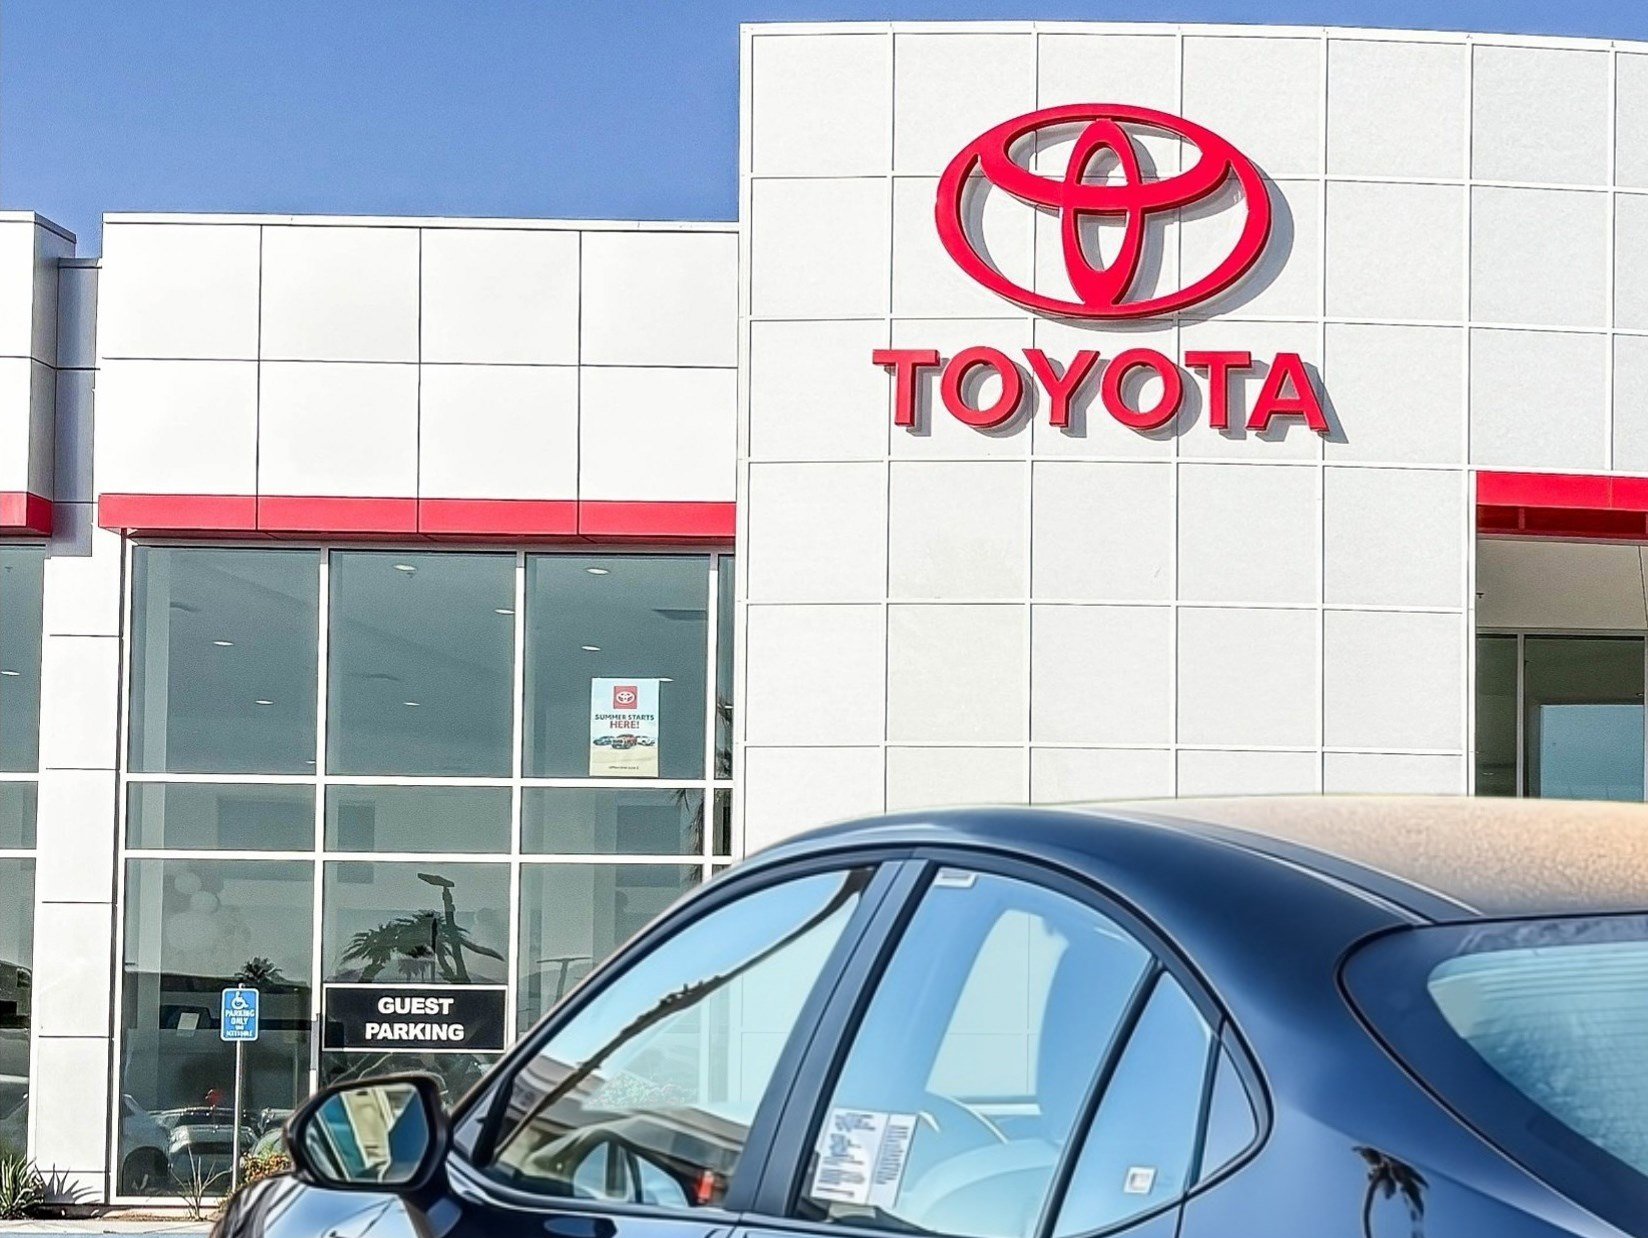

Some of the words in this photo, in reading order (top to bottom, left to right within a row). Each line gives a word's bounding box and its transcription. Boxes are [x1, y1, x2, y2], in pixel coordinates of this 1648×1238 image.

[872, 346, 1330, 433] TOYOTA
[594, 713, 626, 721] SUMMER
[627, 713, 655, 721] STARTS
[609, 720, 640, 729] HERE!
[378, 996, 454, 1015] GUEST
[225, 1009, 255, 1017] PARKING
[230, 1016, 249, 1025] ONLY
[365, 1022, 465, 1041] PARKING
